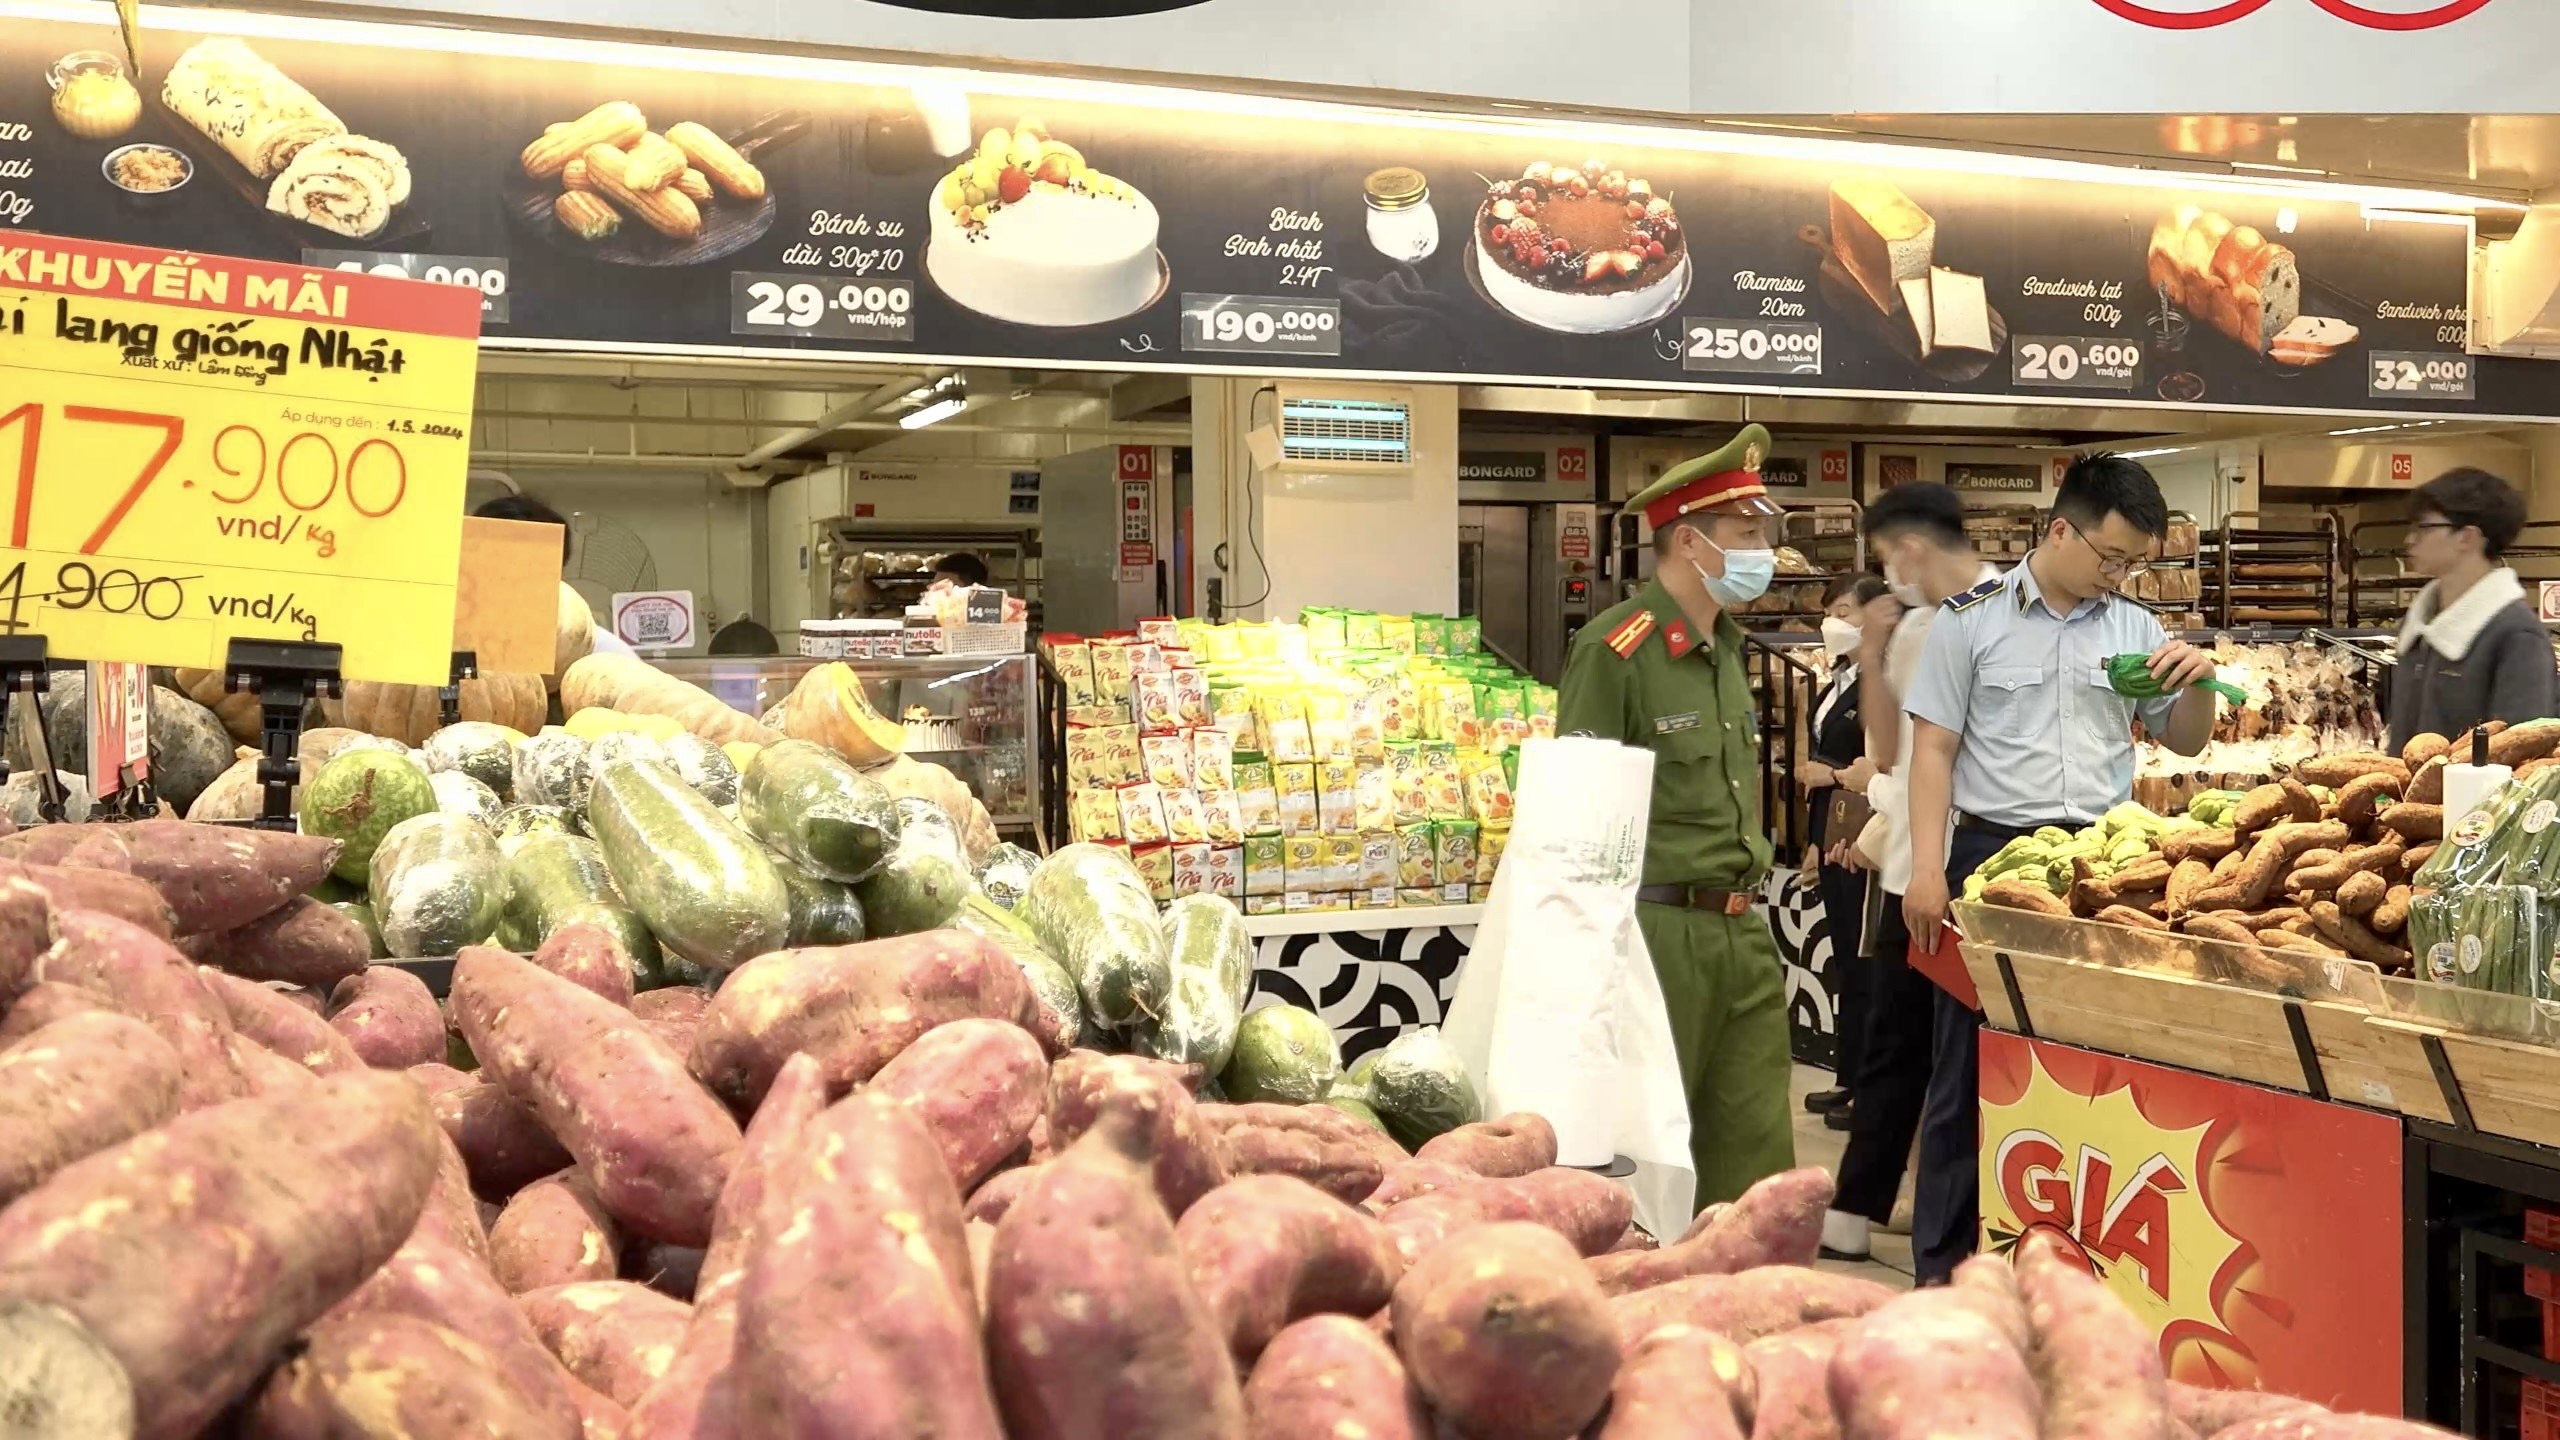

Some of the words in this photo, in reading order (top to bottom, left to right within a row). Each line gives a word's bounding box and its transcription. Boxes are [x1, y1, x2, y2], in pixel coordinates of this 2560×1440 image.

[0, 158, 33, 178] ai
[809, 210, 871, 236] Bánh
[876, 220, 904, 237] su
[1269, 207, 1323, 232] Bánh
[782, 243, 822, 265] dài
[1224, 234, 1272, 257] Sinh
[1275, 239, 1322, 262] nhật
[0, 244, 230, 304] KHUYẾN
[244, 273, 349, 318] MÃI
[1733, 270, 1805, 292] Tiramisu
[2022, 276, 2097, 298] Sandwich
[2100, 281, 2122, 301] lạt
[1759, 297, 1805, 316] 20cm
[2083, 303, 2122, 328] 600g
[2376, 300, 2442, 319] Sandwich
[848, 312, 906, 328] vnd/hộp
[56, 296, 158, 356] lang
[172, 319, 290, 375] giống
[300, 327, 406, 382] Nhật
[199, 359, 230, 375] Lâm
[2095, 367, 2132, 378] vnd/gói
[280, 407, 301, 422] Áp
[305, 412, 342, 428] dụng
[346, 415, 373, 430] đến
[1122, 452, 1149, 473] 01
[1459, 465, 1537, 478] BONGARD
[1559, 455, 1585, 473] 02
[1822, 457, 1846, 475] 03
[2393, 459, 2411, 475] 05
[1760, 471, 1799, 483] GARD
[2054, 465, 2066, 480] 0
[1970, 477, 2034, 489] BONGARD
[844, 638, 871, 647] nutella
[875, 638, 902, 647] nutella
[905, 629, 942, 640] nutella
[1996, 1130, 2188, 1305] GIÁ
